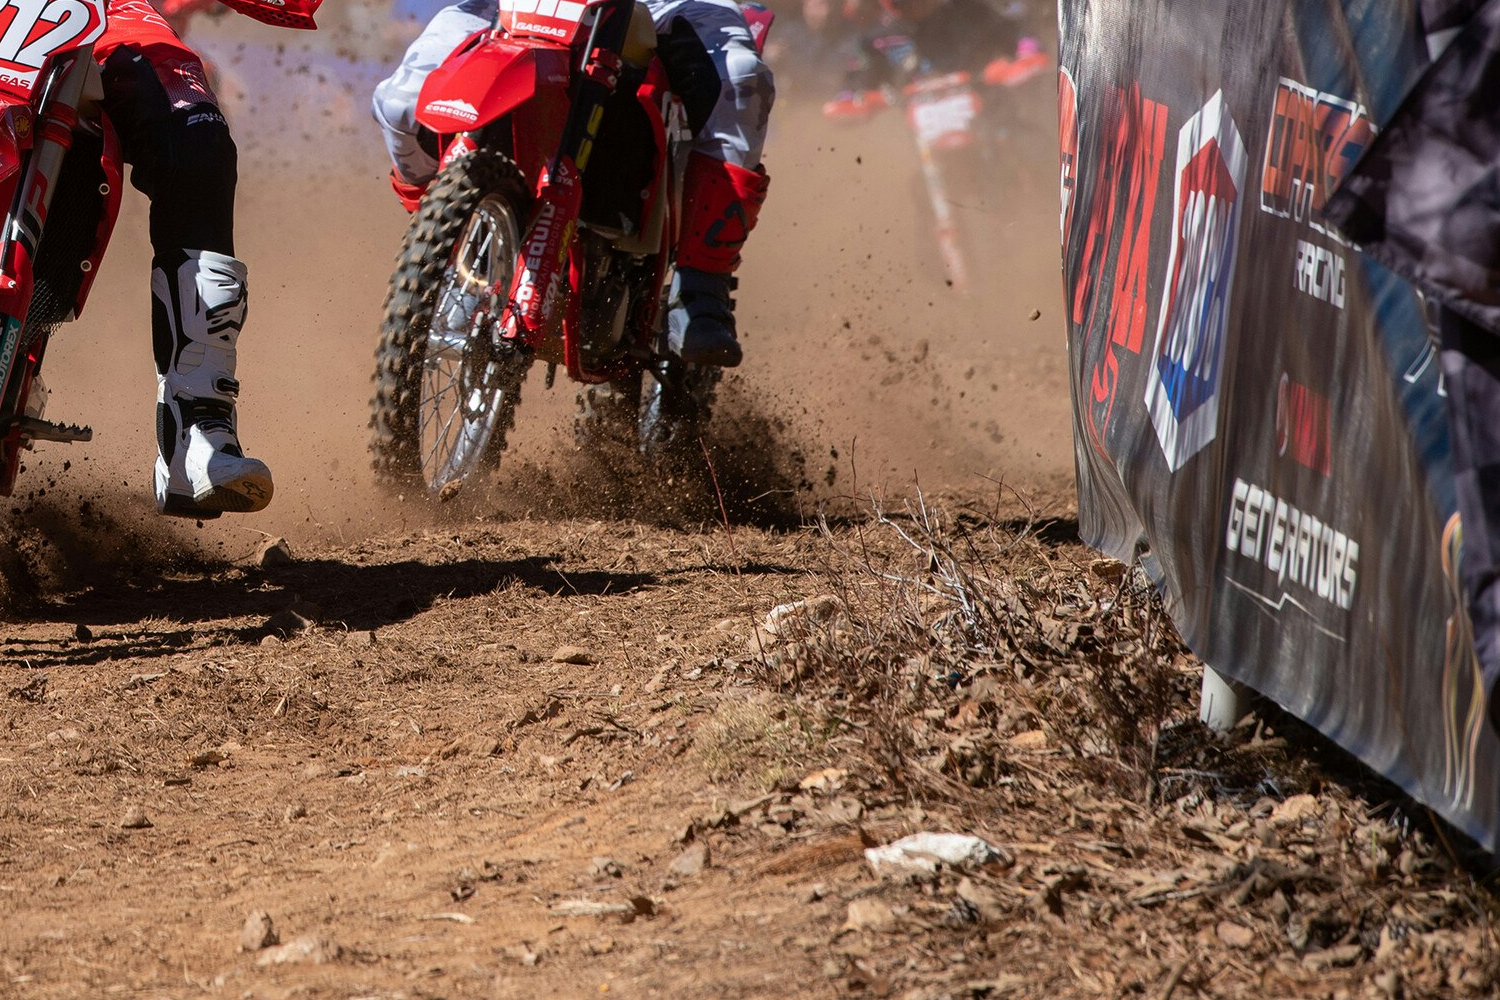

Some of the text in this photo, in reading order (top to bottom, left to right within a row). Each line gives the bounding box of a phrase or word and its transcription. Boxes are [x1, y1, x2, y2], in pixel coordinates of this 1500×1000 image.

[514, 21, 568, 38] GASGAS
[425, 104, 478, 122] COBEQUID
[1293, 239, 1346, 310] RACING
[1225, 476, 1360, 611] GENERATORS
